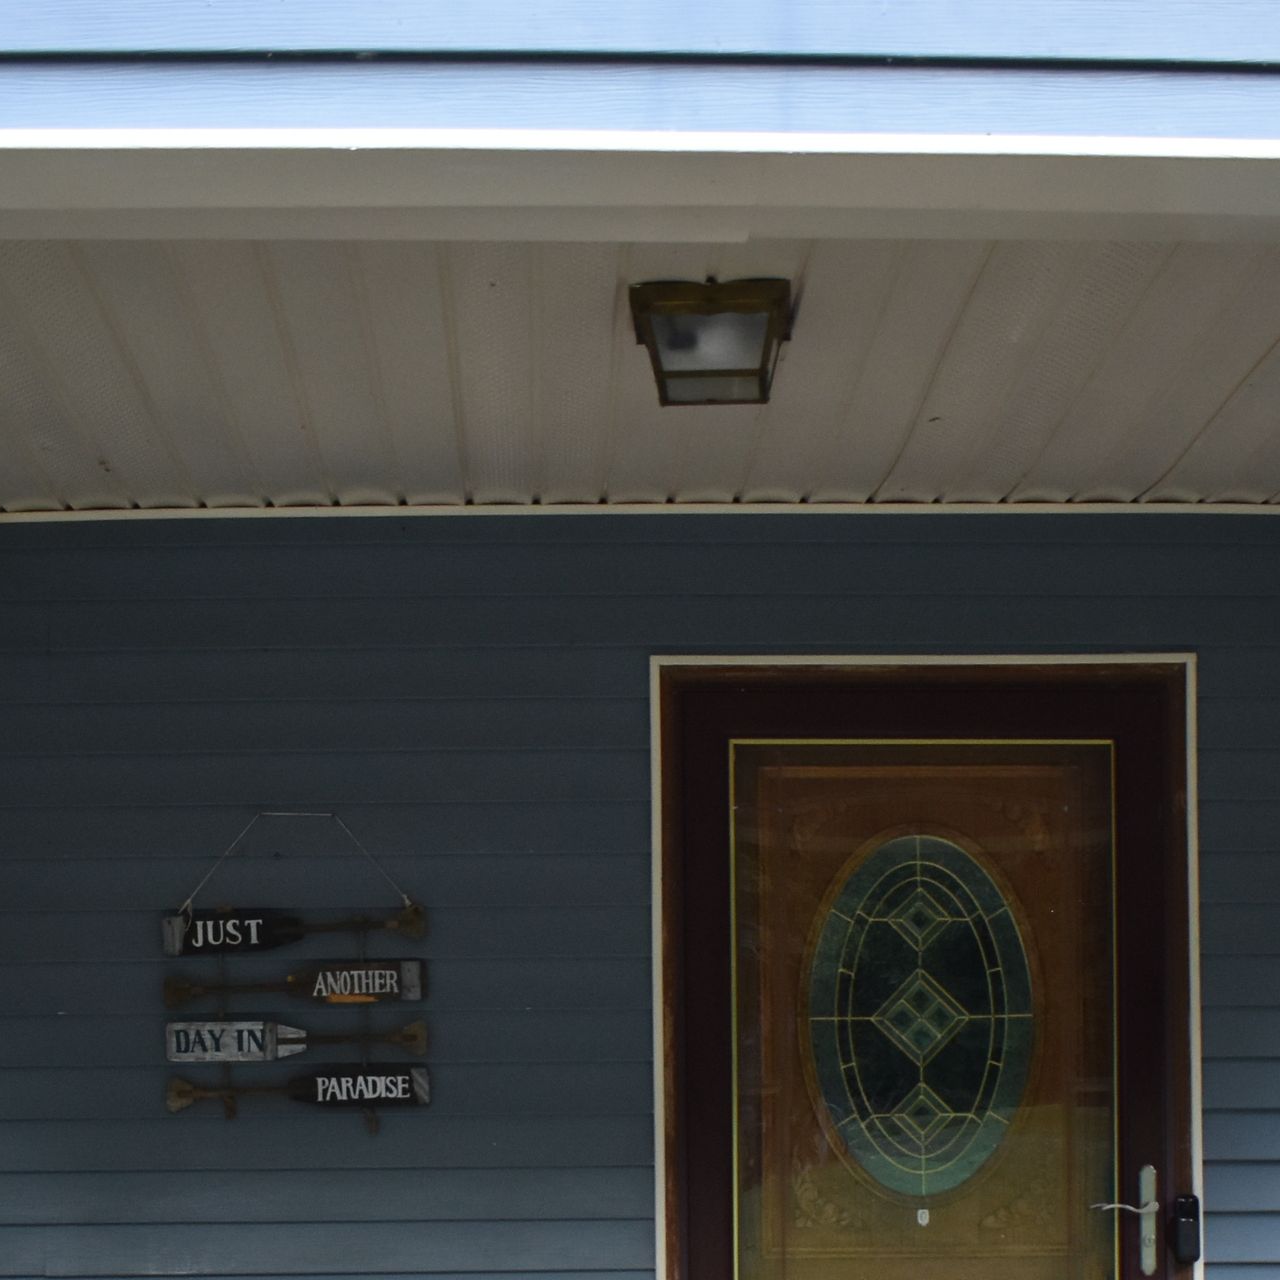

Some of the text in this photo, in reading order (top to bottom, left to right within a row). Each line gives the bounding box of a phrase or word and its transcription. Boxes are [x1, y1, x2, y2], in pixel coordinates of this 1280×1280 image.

[192, 919, 263, 948] JUST
[313, 970, 399, 997] ANOTHER
[175, 1028, 265, 1054] DAY IN
[316, 1075, 410, 1102] PARADISE
